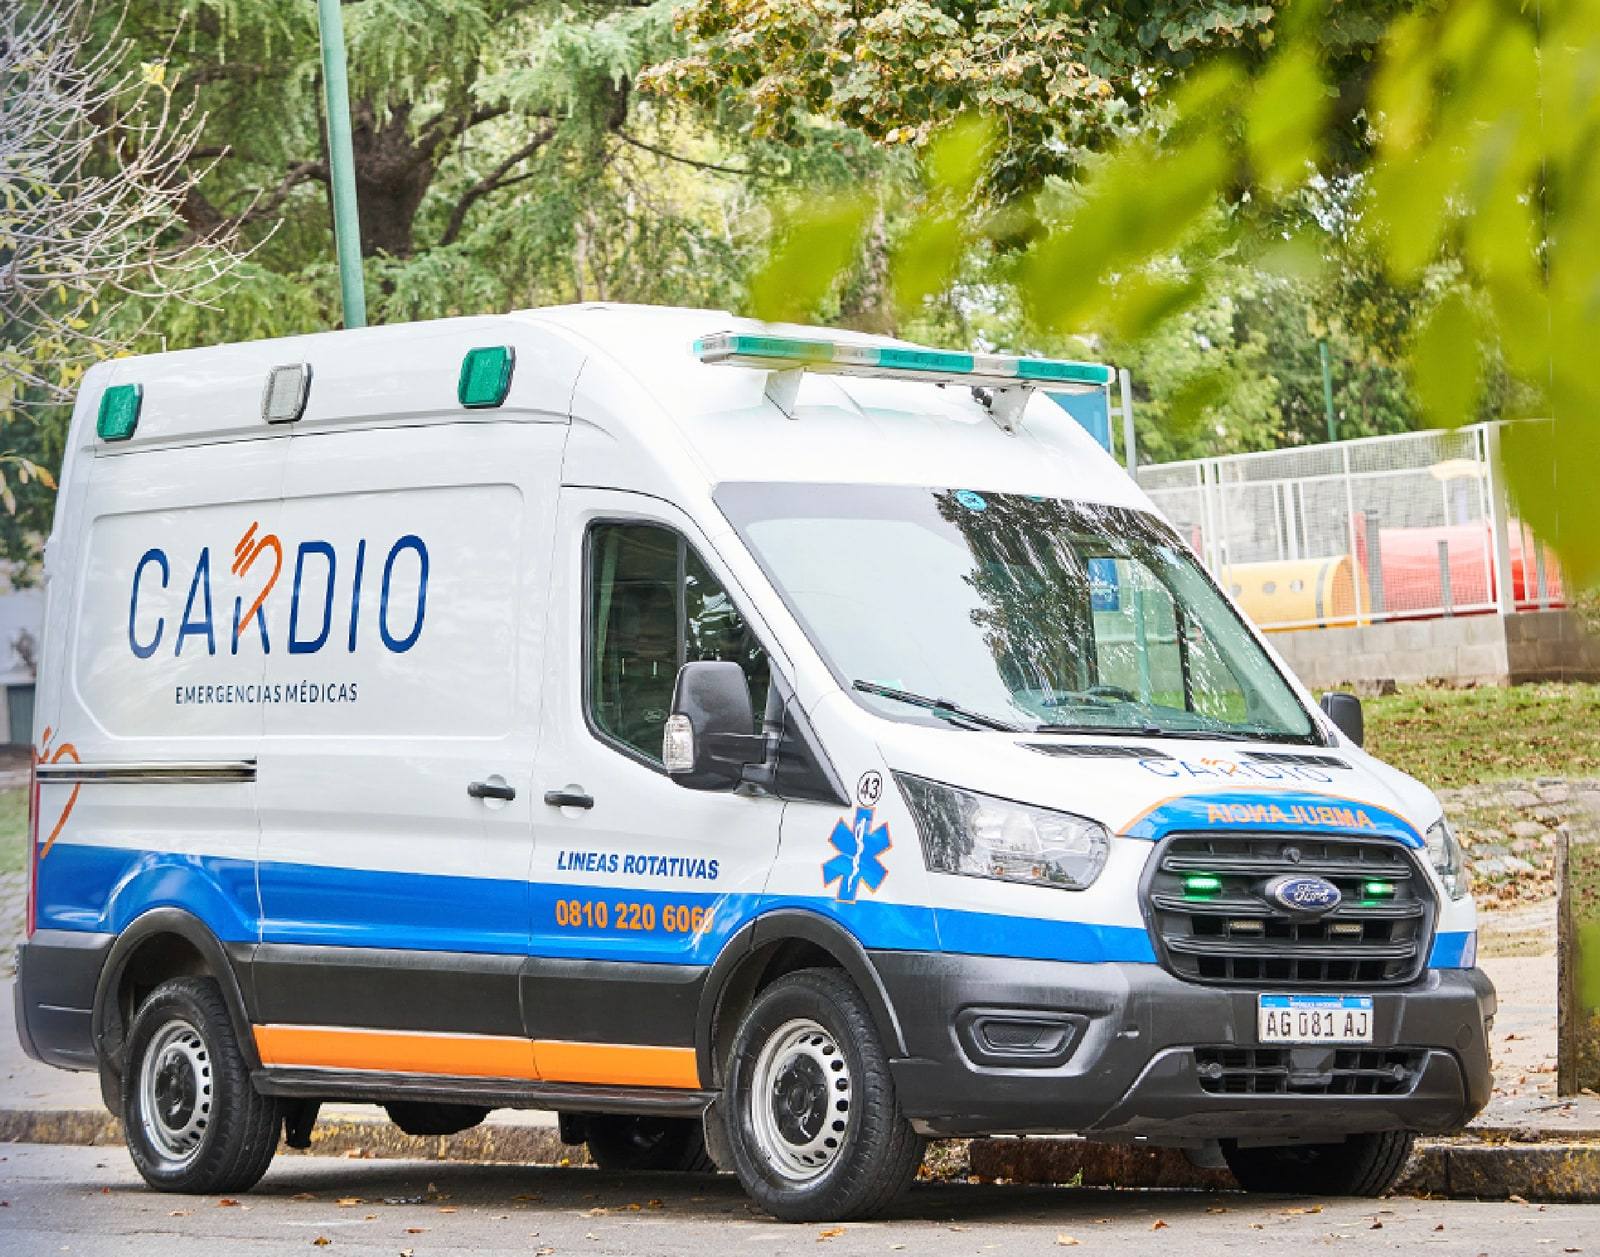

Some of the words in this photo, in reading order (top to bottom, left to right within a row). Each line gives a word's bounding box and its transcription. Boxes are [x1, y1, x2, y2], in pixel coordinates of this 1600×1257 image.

[129, 521, 430, 659] CARDIO
[175, 684, 281, 705] EMERGENCIAS
[285, 680, 358, 704] MÉDICAS
[860, 777, 880, 800] 43
[556, 850, 620, 874] LINEAS
[623, 854, 720, 881] ROTATIVAS
[1293, 883, 1329, 903] Ford
[555, 899, 608, 929] 0810
[614, 901, 656, 931] 220
[1266, 1010, 1292, 1037] AG
[1298, 1010, 1335, 1037] 081
[1343, 1010, 1368, 1037] AJ
